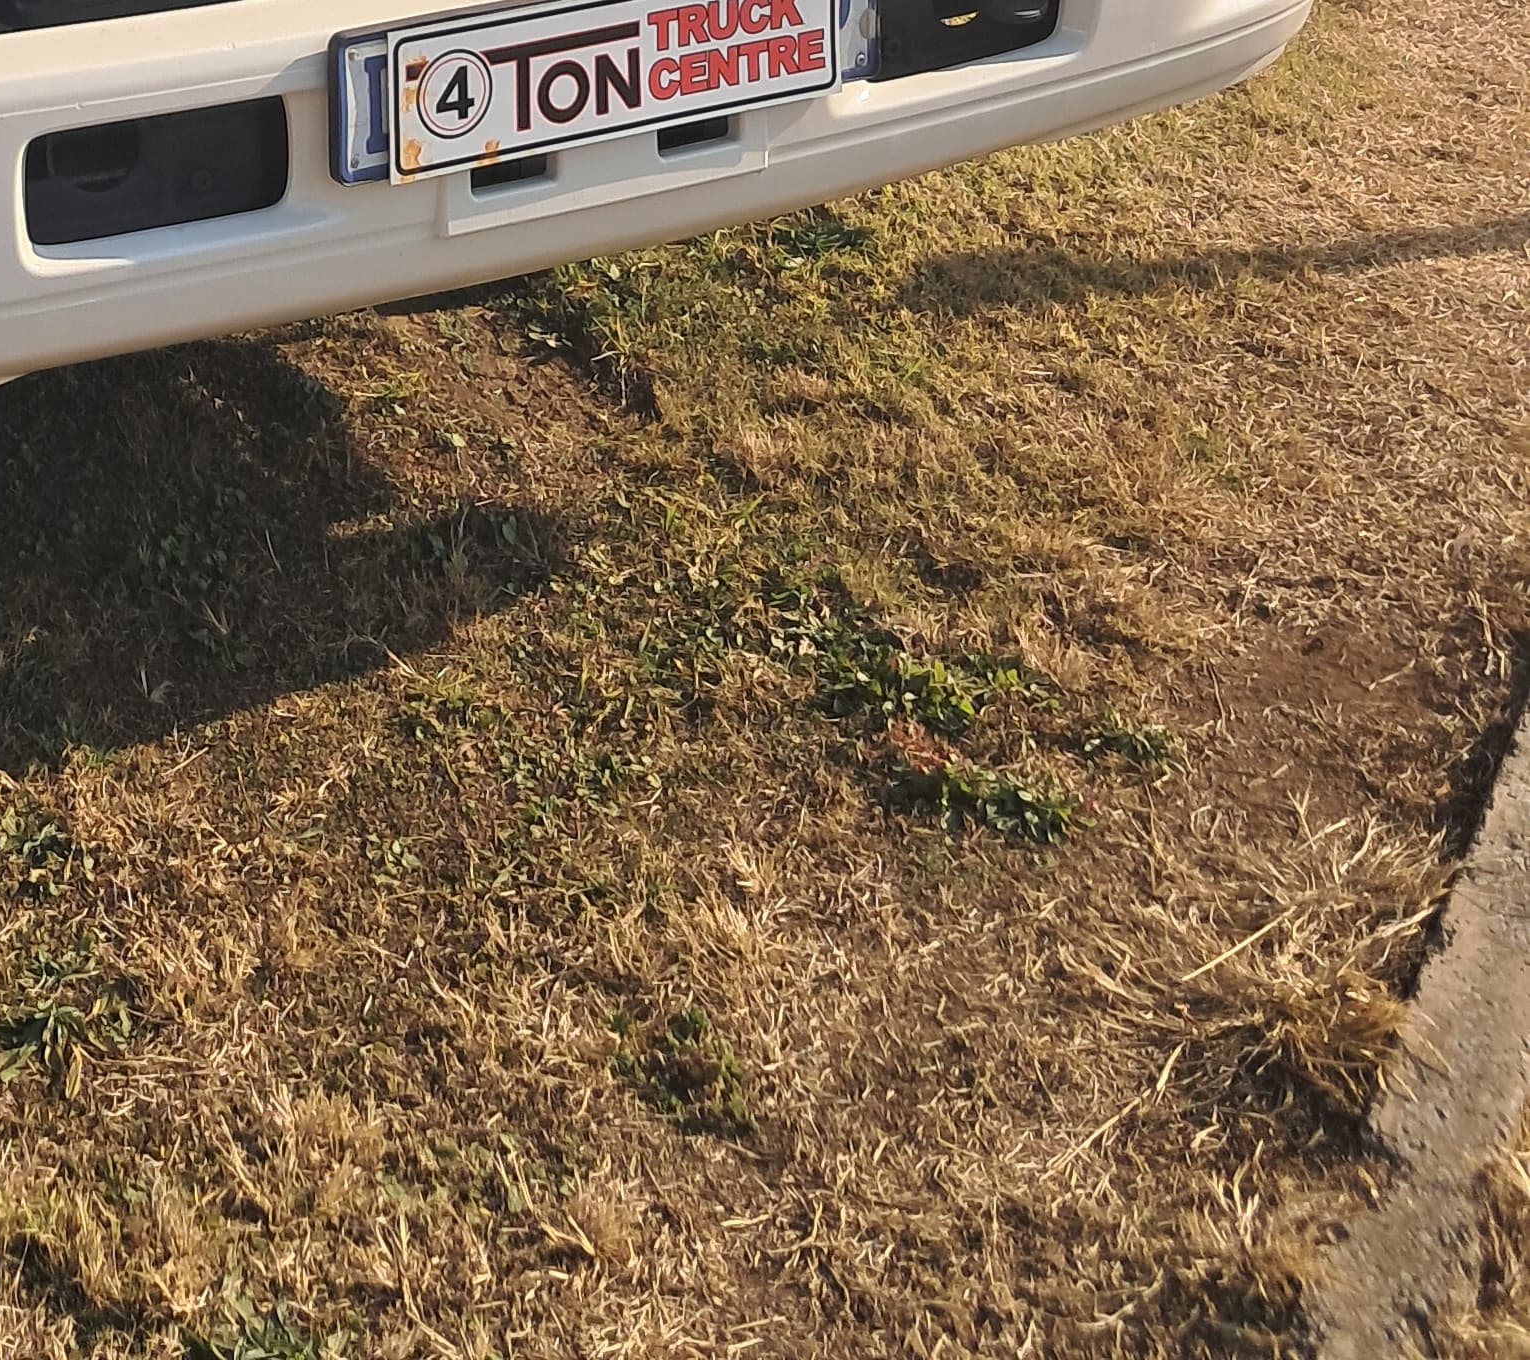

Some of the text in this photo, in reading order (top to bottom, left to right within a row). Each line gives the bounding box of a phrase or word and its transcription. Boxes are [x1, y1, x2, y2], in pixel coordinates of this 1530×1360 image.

[435, 63, 476, 122] 4
[483, 20, 642, 133] TON
[646, 27, 827, 102] CENTRE
